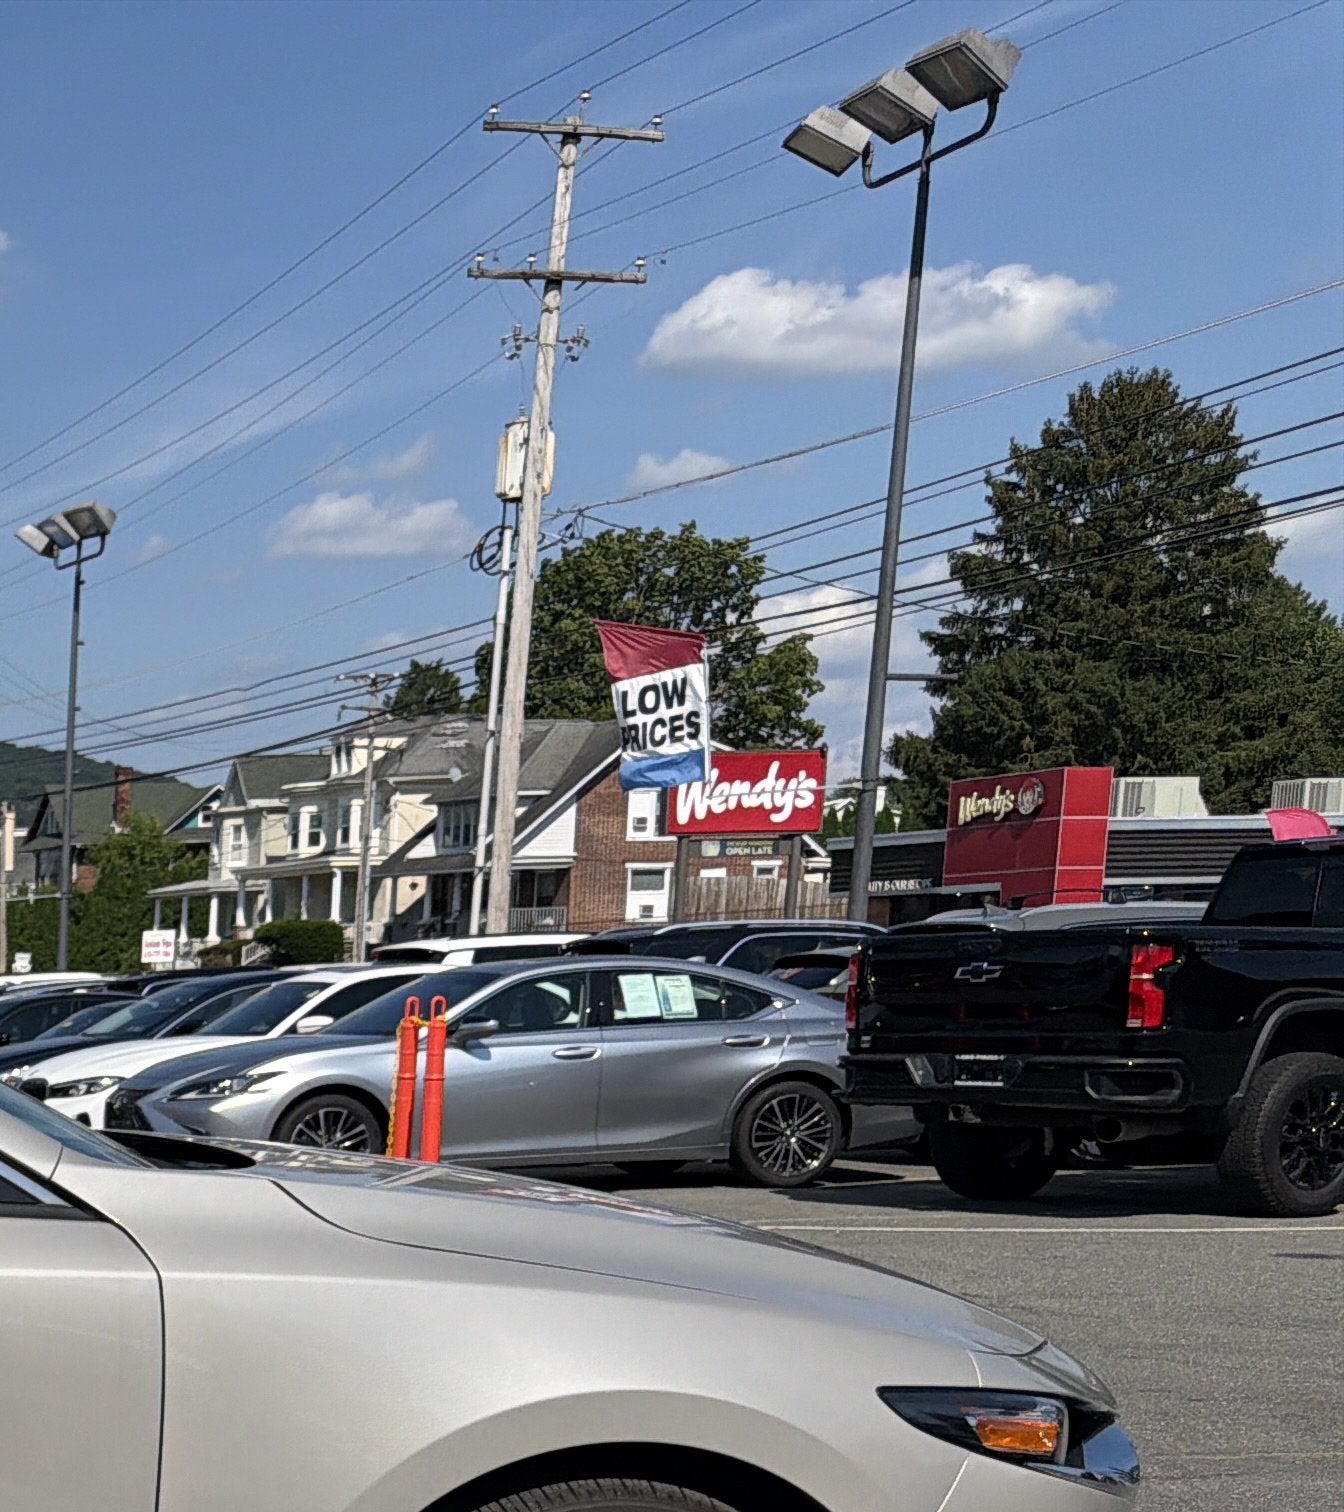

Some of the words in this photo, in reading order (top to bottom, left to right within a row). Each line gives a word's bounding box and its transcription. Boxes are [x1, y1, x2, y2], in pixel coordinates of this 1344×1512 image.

[620, 676, 688, 719] LOW
[620, 710, 702, 753] PRICES
[675, 760, 819, 826] Wendy's
[957, 784, 1015, 826] Wendy's
[725, 846, 751, 856] OPEN
[751, 846, 773, 855] LATE
